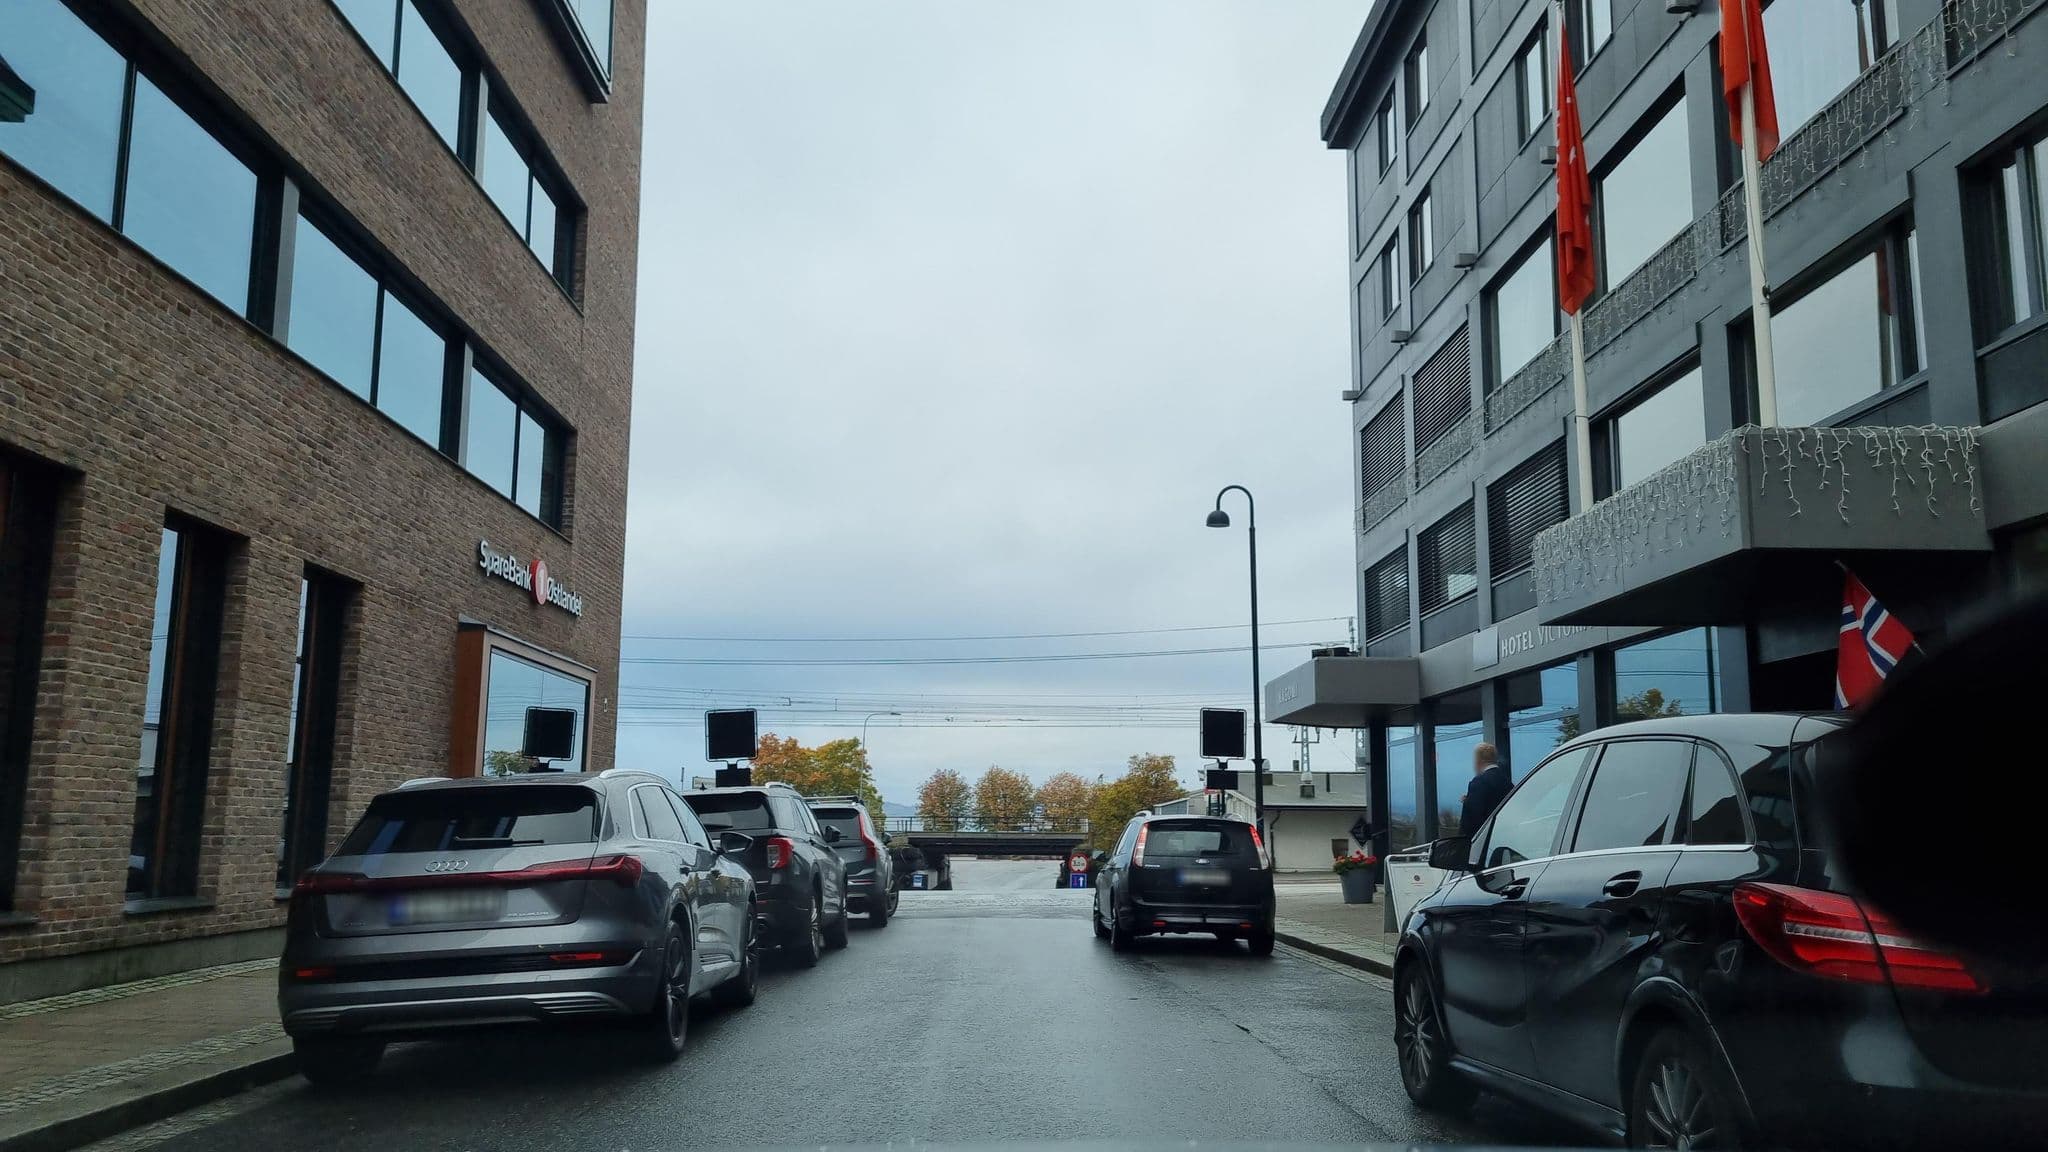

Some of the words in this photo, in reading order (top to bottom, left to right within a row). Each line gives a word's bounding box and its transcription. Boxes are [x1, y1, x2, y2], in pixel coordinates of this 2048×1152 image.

[480, 540, 532, 591] SpareBank
[547, 577, 582, 617] Østlandet
[1501, 630, 1533, 657] HOTEL
[1537, 626, 1592, 644] VICTO
